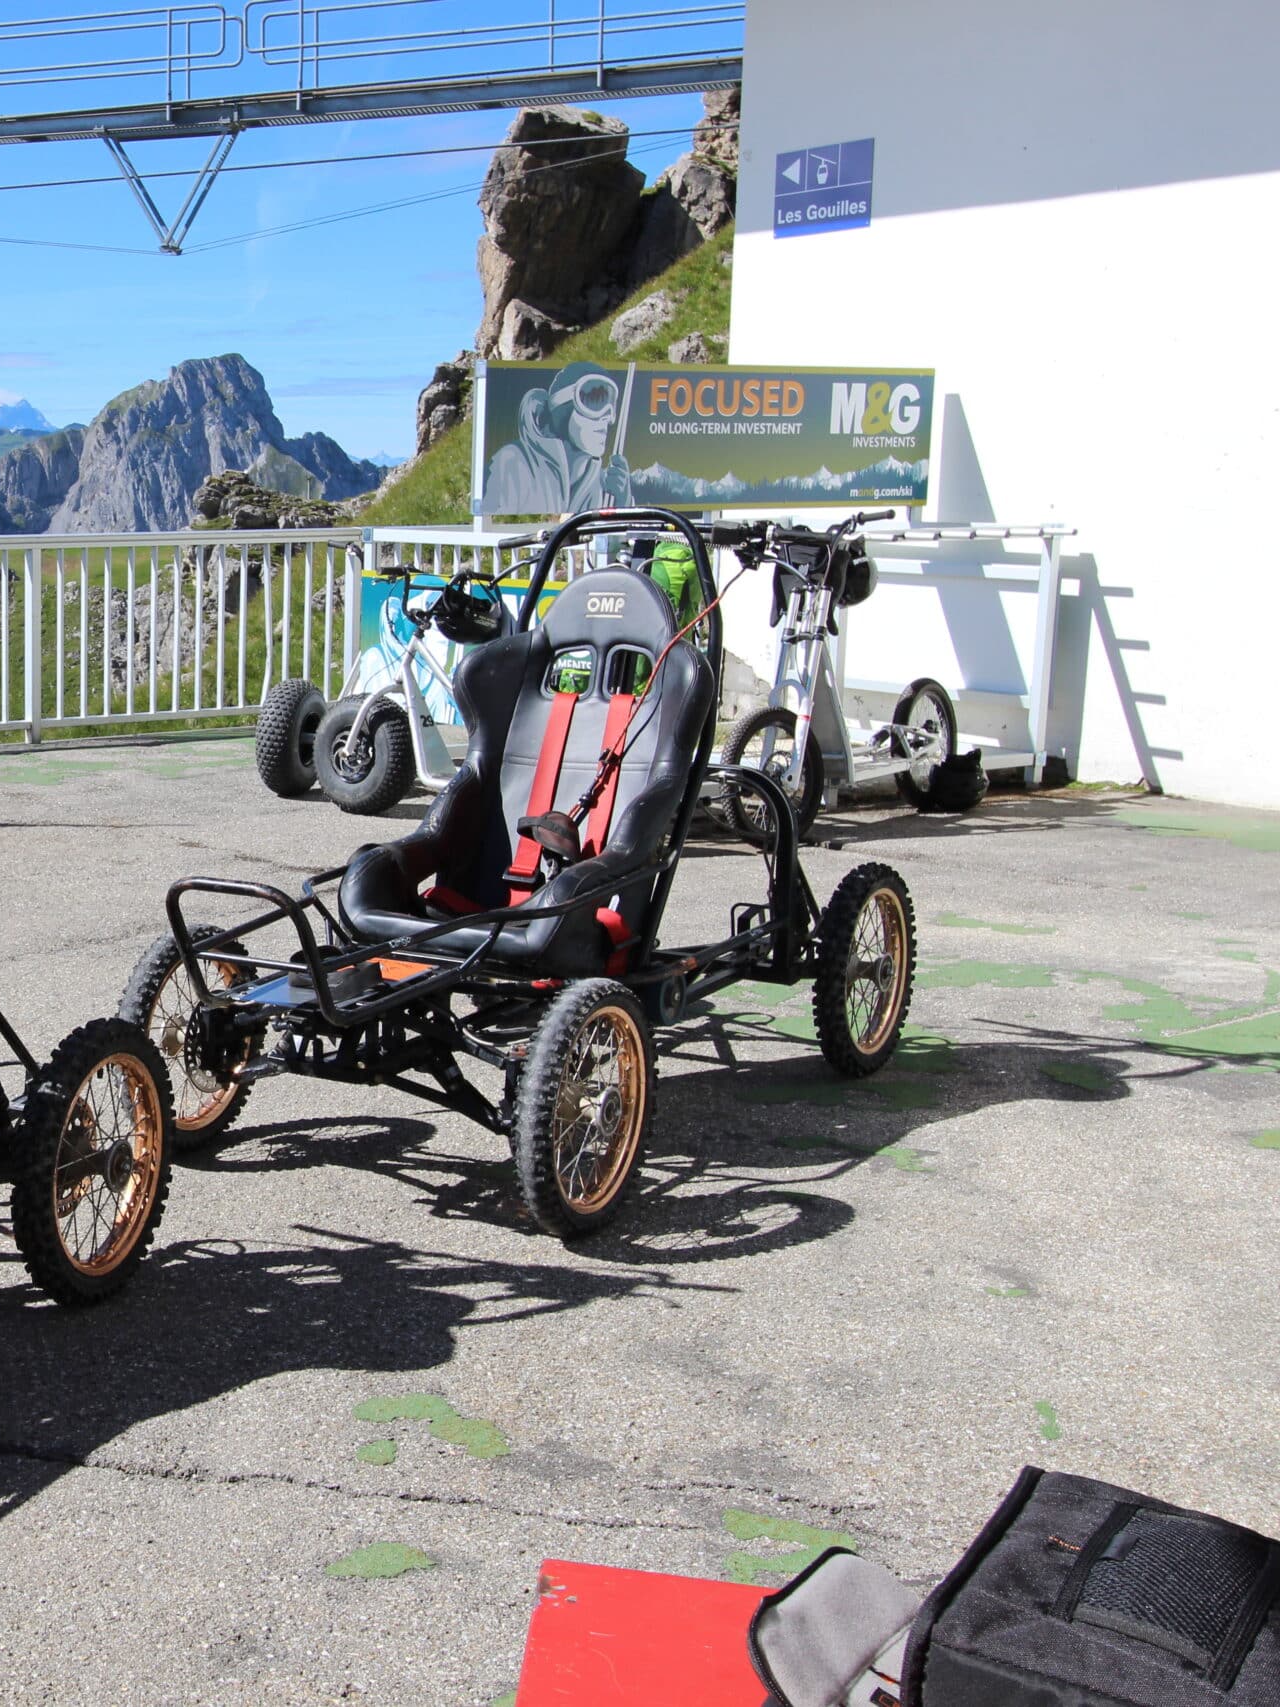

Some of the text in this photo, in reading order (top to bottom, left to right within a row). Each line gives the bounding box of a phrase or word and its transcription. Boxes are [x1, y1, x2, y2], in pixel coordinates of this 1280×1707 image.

[777, 199, 867, 225] Les Gouilles
[649, 378, 805, 417] FOCUSED
[830, 381, 921, 435] M&G
[649, 422, 803, 435] ON LONG-TERM INVESTMENT
[852, 436, 916, 448] INVESTMENTS
[849, 486, 913, 500] mandg.com/ski
[587, 597, 625, 613] OMP
